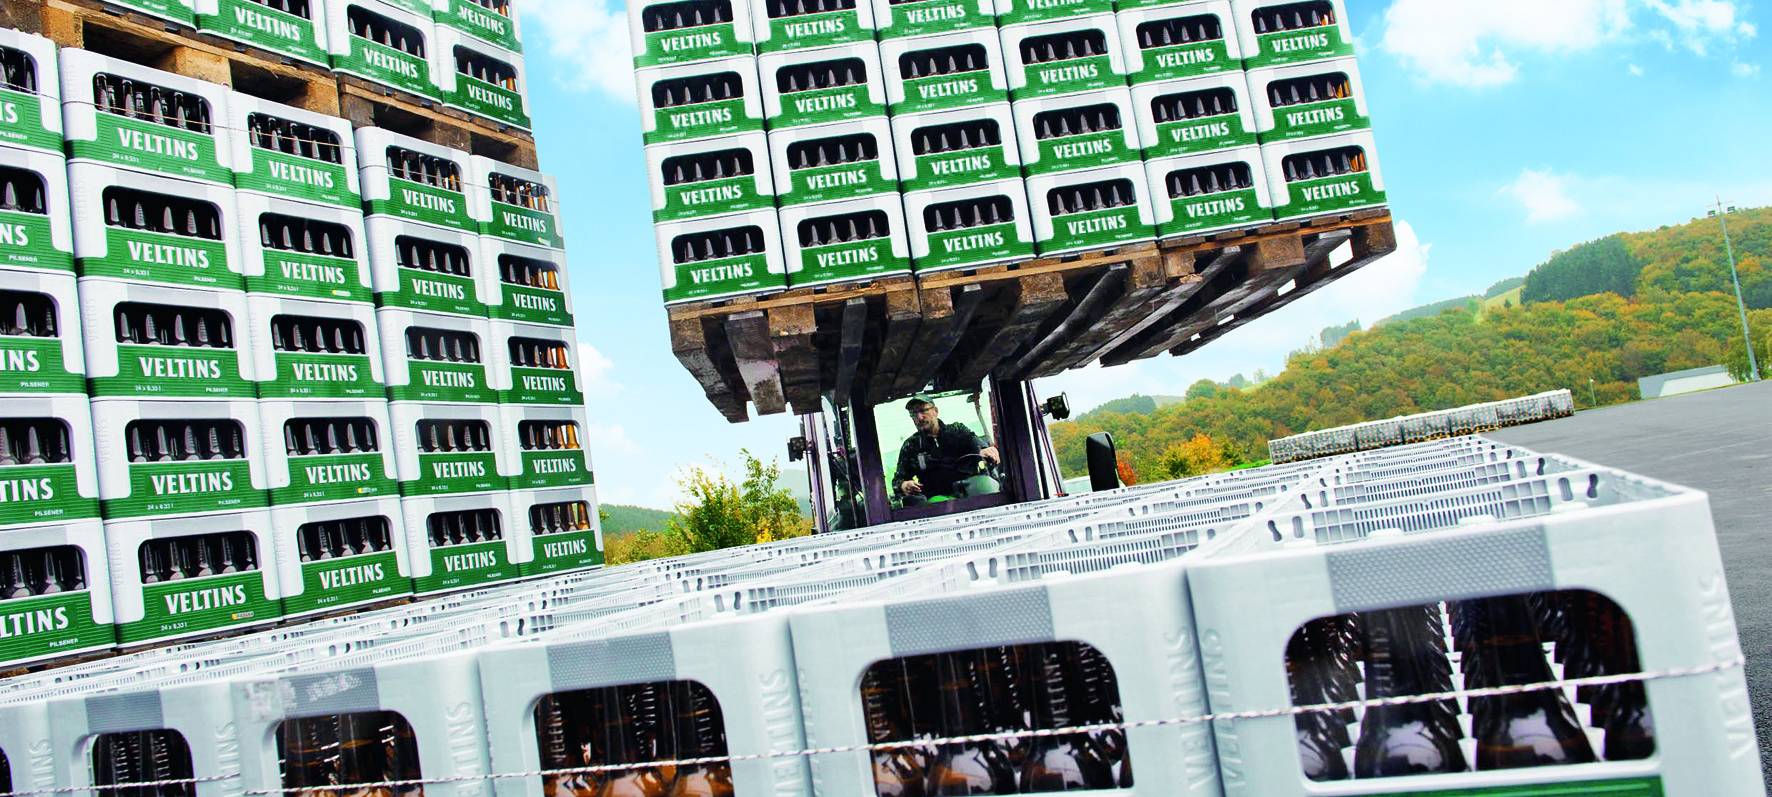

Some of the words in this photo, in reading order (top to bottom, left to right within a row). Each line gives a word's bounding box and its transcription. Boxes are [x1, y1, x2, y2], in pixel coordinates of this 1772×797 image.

[234, 6, 301, 41] VELTINS
[457, 5, 504, 35] VELTINS
[905, 5, 966, 23] VELTINS
[785, 18, 844, 37] VELTINS
[661, 32, 721, 52] VELTINS
[1272, 34, 1328, 52] VELTINS
[363, 46, 417, 78] VELTINS
[1156, 49, 1214, 67] VELTINS
[1040, 64, 1098, 83] VELTINS
[467, 84, 512, 110] VELTINS
[918, 79, 977, 98] VELTINS
[795, 93, 855, 112] VELTINS
[670, 108, 731, 128] VELTINS
[1287, 107, 1343, 126] VELTINS
[1172, 122, 1229, 142] VELTINS
[117, 127, 198, 160] VELTINS
[1053, 139, 1112, 158] VELTINS
[268, 160, 333, 188] VELTINS
[931, 155, 990, 175] VELTINS
[807, 170, 866, 189] VELTINS
[402, 189, 455, 213] VELTINS
[680, 185, 742, 205] VELTINS
[1302, 181, 1359, 201] VELTINS
[1186, 197, 1244, 217] VELTINS
[503, 212, 546, 233] VELTINS
[1067, 215, 1126, 235] VELTINS
[943, 232, 1003, 252] VELTINS
[127, 241, 209, 268] VELTINS
[817, 247, 877, 267] VELTINS
[280, 261, 345, 284] VELTINS
[691, 263, 752, 283] VELTINS
[412, 279, 464, 299] VELTINS
[513, 293, 555, 311] VELTINS
[139, 357, 220, 378] VELTINS
[292, 363, 357, 381] VELTINS
[422, 370, 474, 387] VELTINS
[523, 376, 565, 391] VELTINS
[305, 464, 370, 484] VELTINS
[433, 462, 485, 478] VELTINS
[533, 458, 576, 473] VELTINS
[151, 472, 232, 494] VELTINS
[544, 539, 586, 558] VELTINS
[444, 551, 496, 572] VELTINS
[319, 563, 383, 589] VELTINS
[164, 585, 245, 614] VELTINS
[49, 638, 79, 648] PILSENER
